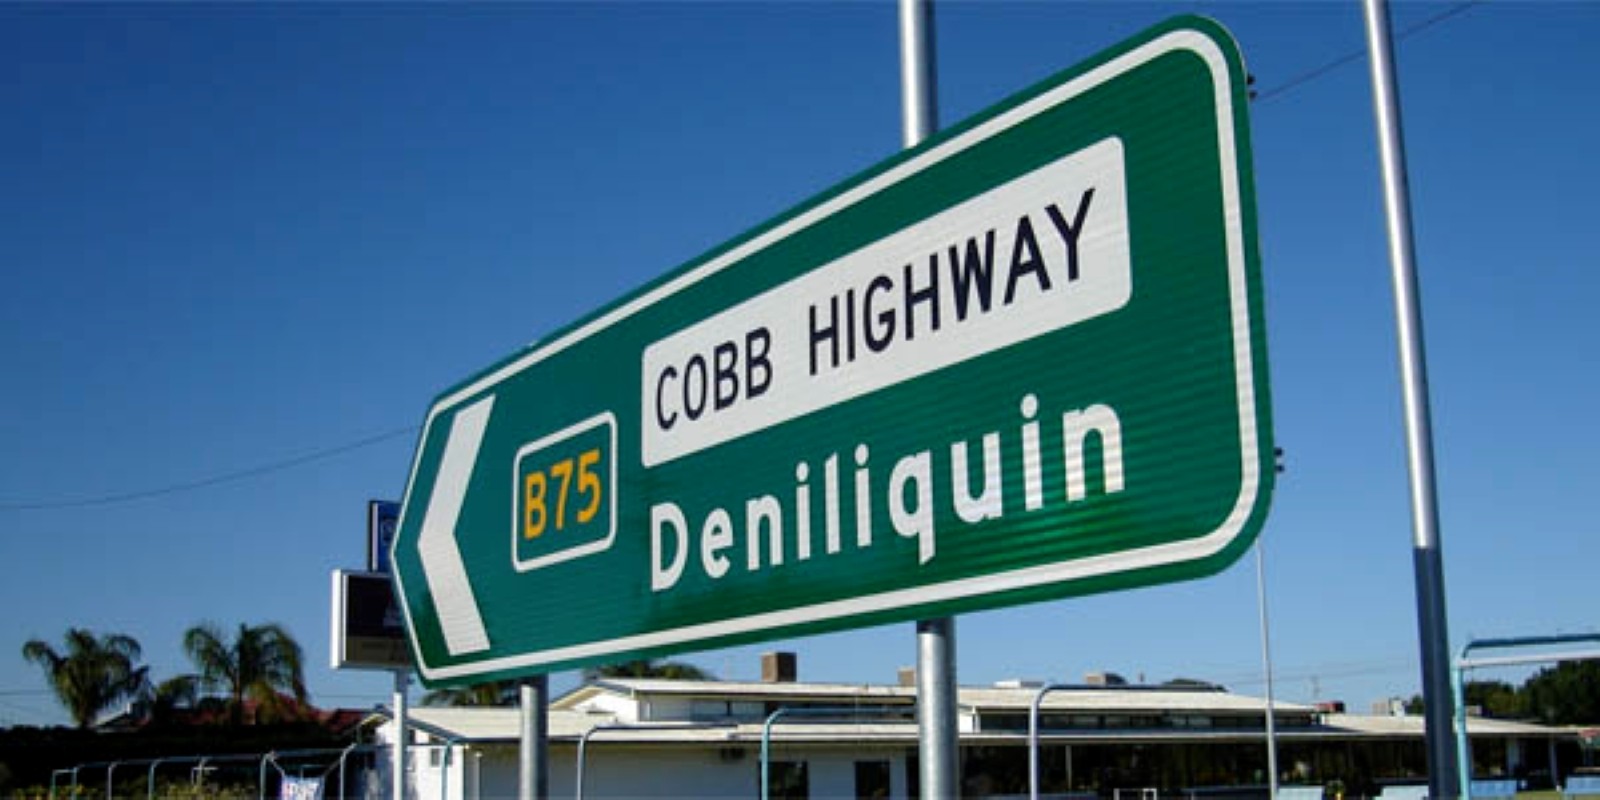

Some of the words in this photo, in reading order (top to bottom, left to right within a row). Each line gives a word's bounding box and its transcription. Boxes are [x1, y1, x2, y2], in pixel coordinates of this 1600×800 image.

[656, 326, 773, 432] COBB
[808, 187, 1096, 376] HIGHWAY
[523, 449, 602, 539] B75
[650, 394, 1124, 593] Deniliquin
